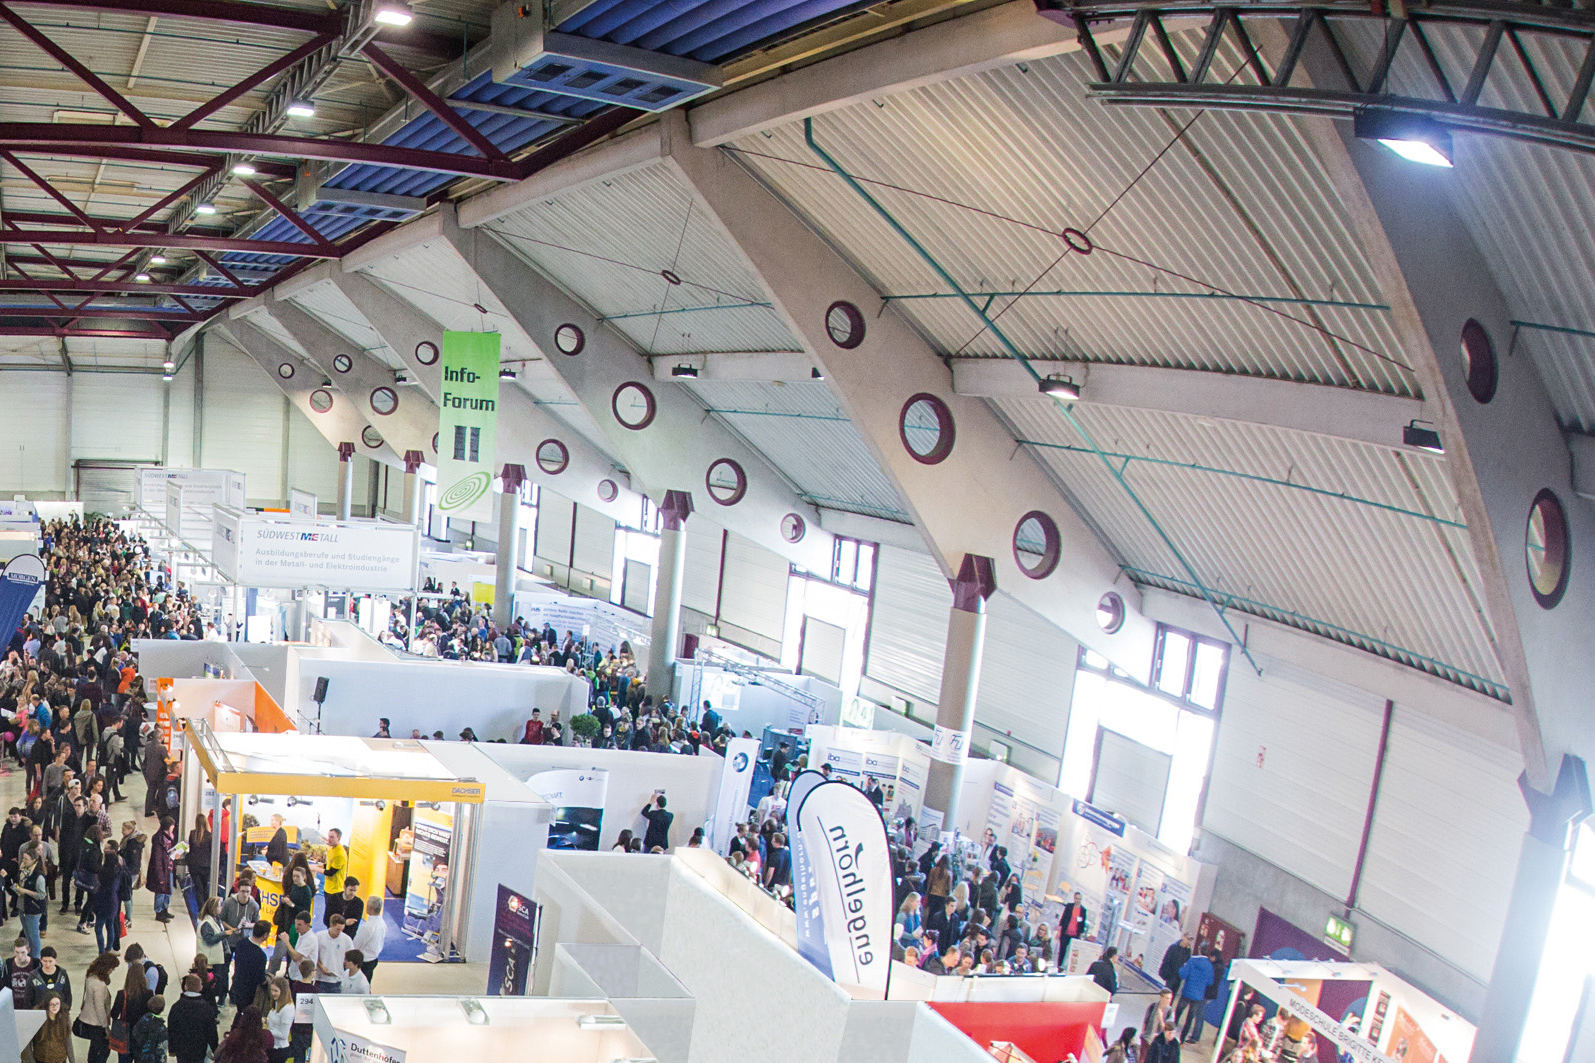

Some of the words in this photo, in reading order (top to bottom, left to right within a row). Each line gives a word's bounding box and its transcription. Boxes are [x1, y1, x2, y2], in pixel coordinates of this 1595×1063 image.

[444, 365, 481, 383] Info-
[442, 392, 495, 411] Forum
[453, 425, 481, 462] II
[256, 528, 339, 543] SÜDWESTMETALL
[256, 548, 329, 561] Ausbildungsberufe
[331, 551, 346, 561] und
[347, 552, 400, 563] Studiengänge
[255, 558, 262, 566] in
[264, 558, 278, 567] der
[279, 559, 307, 568] Metall-
[309, 561, 324, 569] und
[325, 562, 388, 572] Elektroindustrie
[452, 787, 481, 795] DACHSER
[1289, 998, 1337, 1037] MODESCHULE
[1337, 1031, 1372, 1061] BRIGITTE
